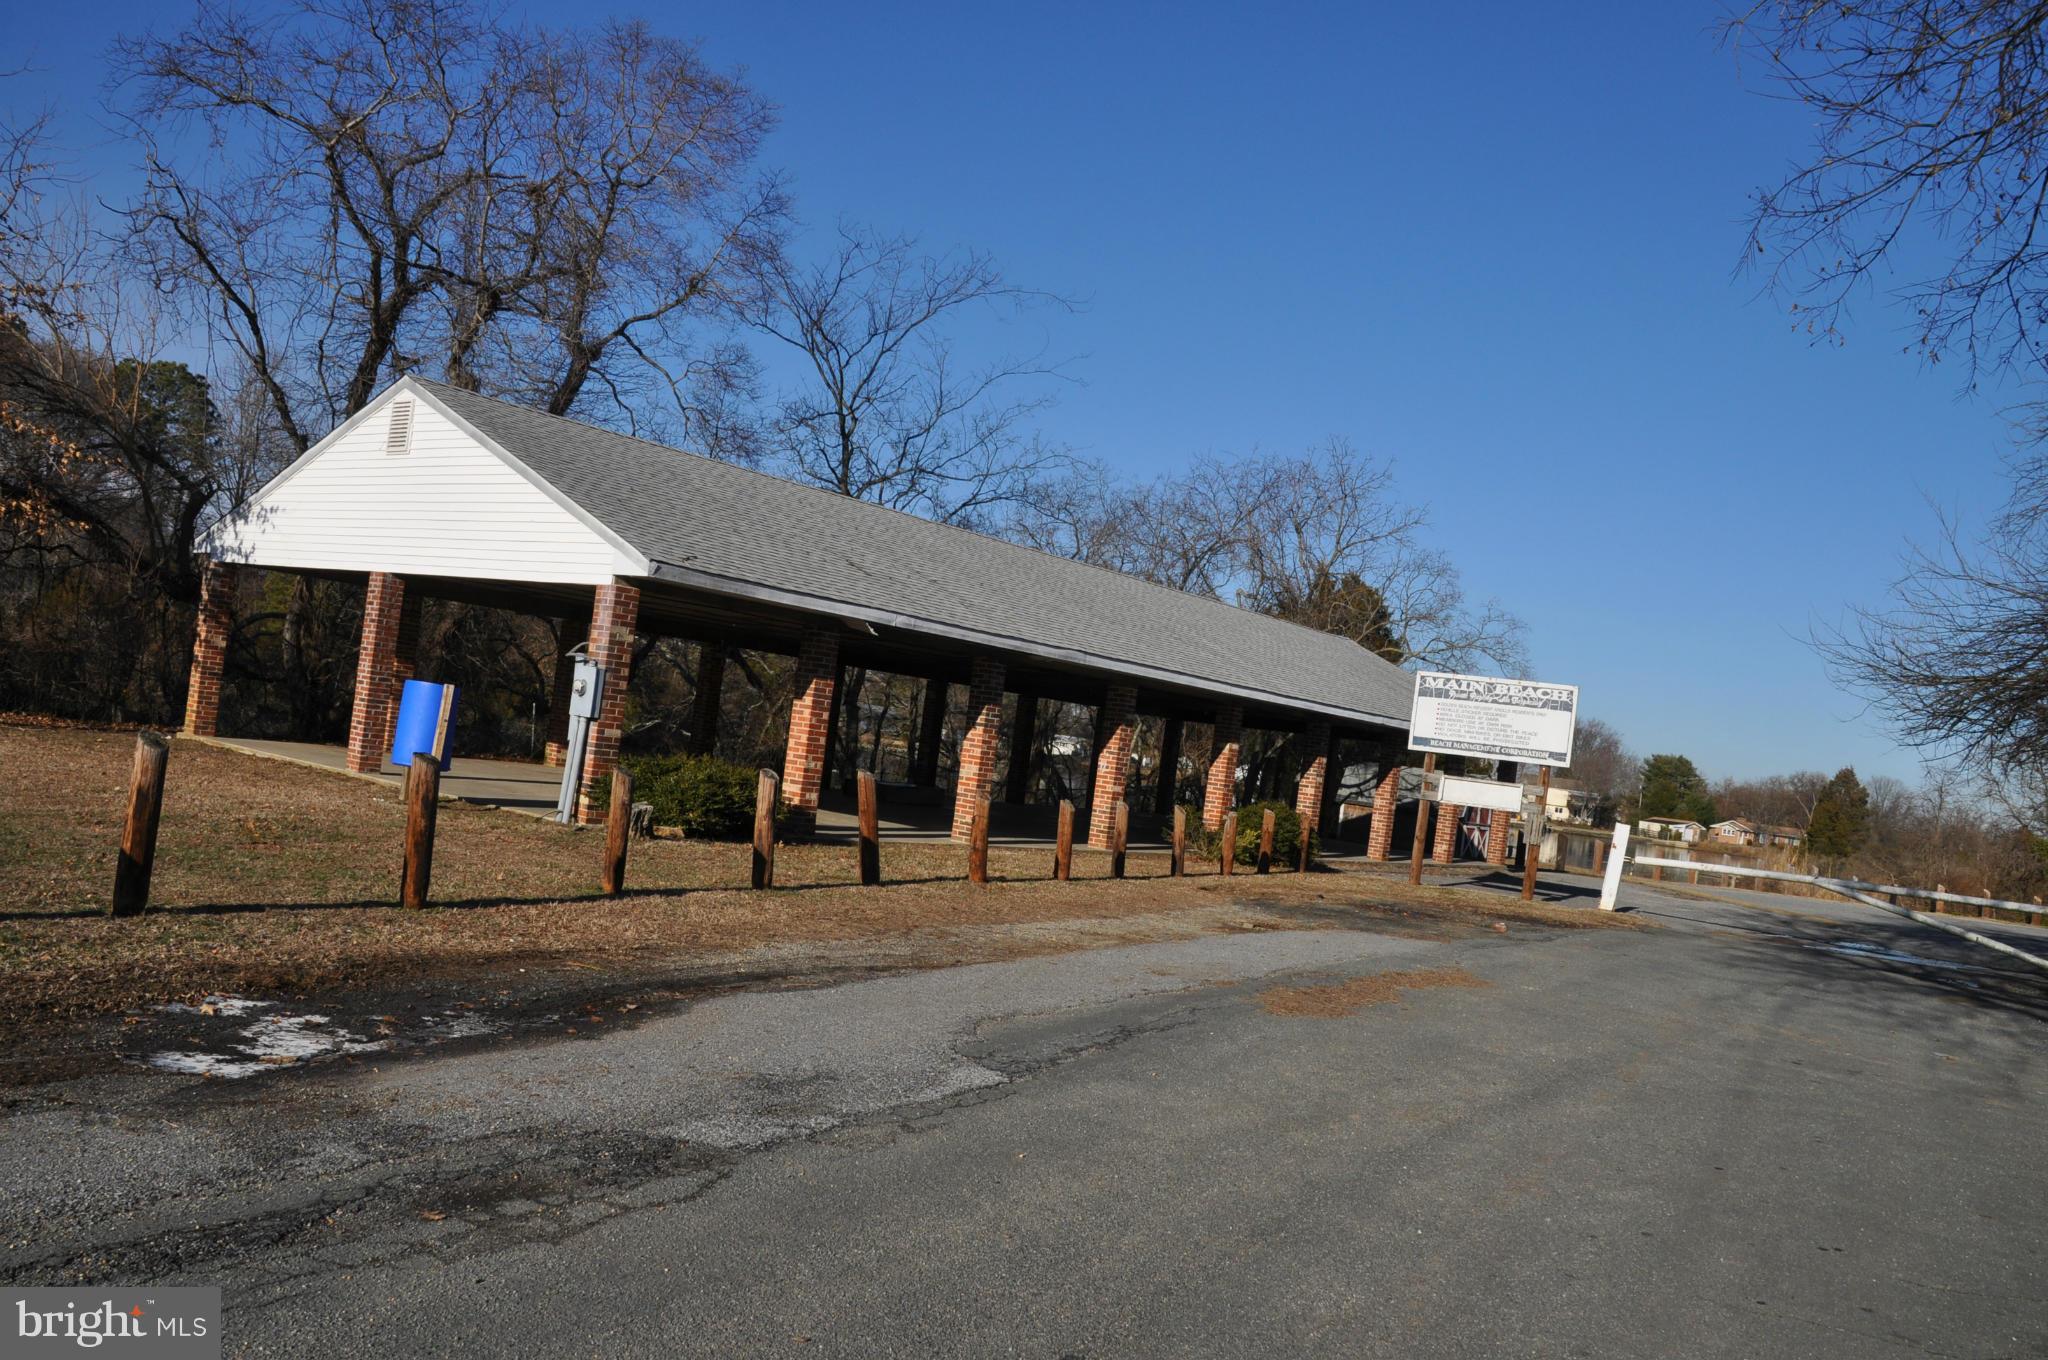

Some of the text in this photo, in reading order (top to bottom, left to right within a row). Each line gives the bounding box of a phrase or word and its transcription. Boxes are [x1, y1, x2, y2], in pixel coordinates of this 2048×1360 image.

[1424, 676, 1486, 694] MAIN
[1495, 684, 1571, 701] BEACH
[1430, 740, 1549, 759] BEACH MANAGEMENT CORPORATION
